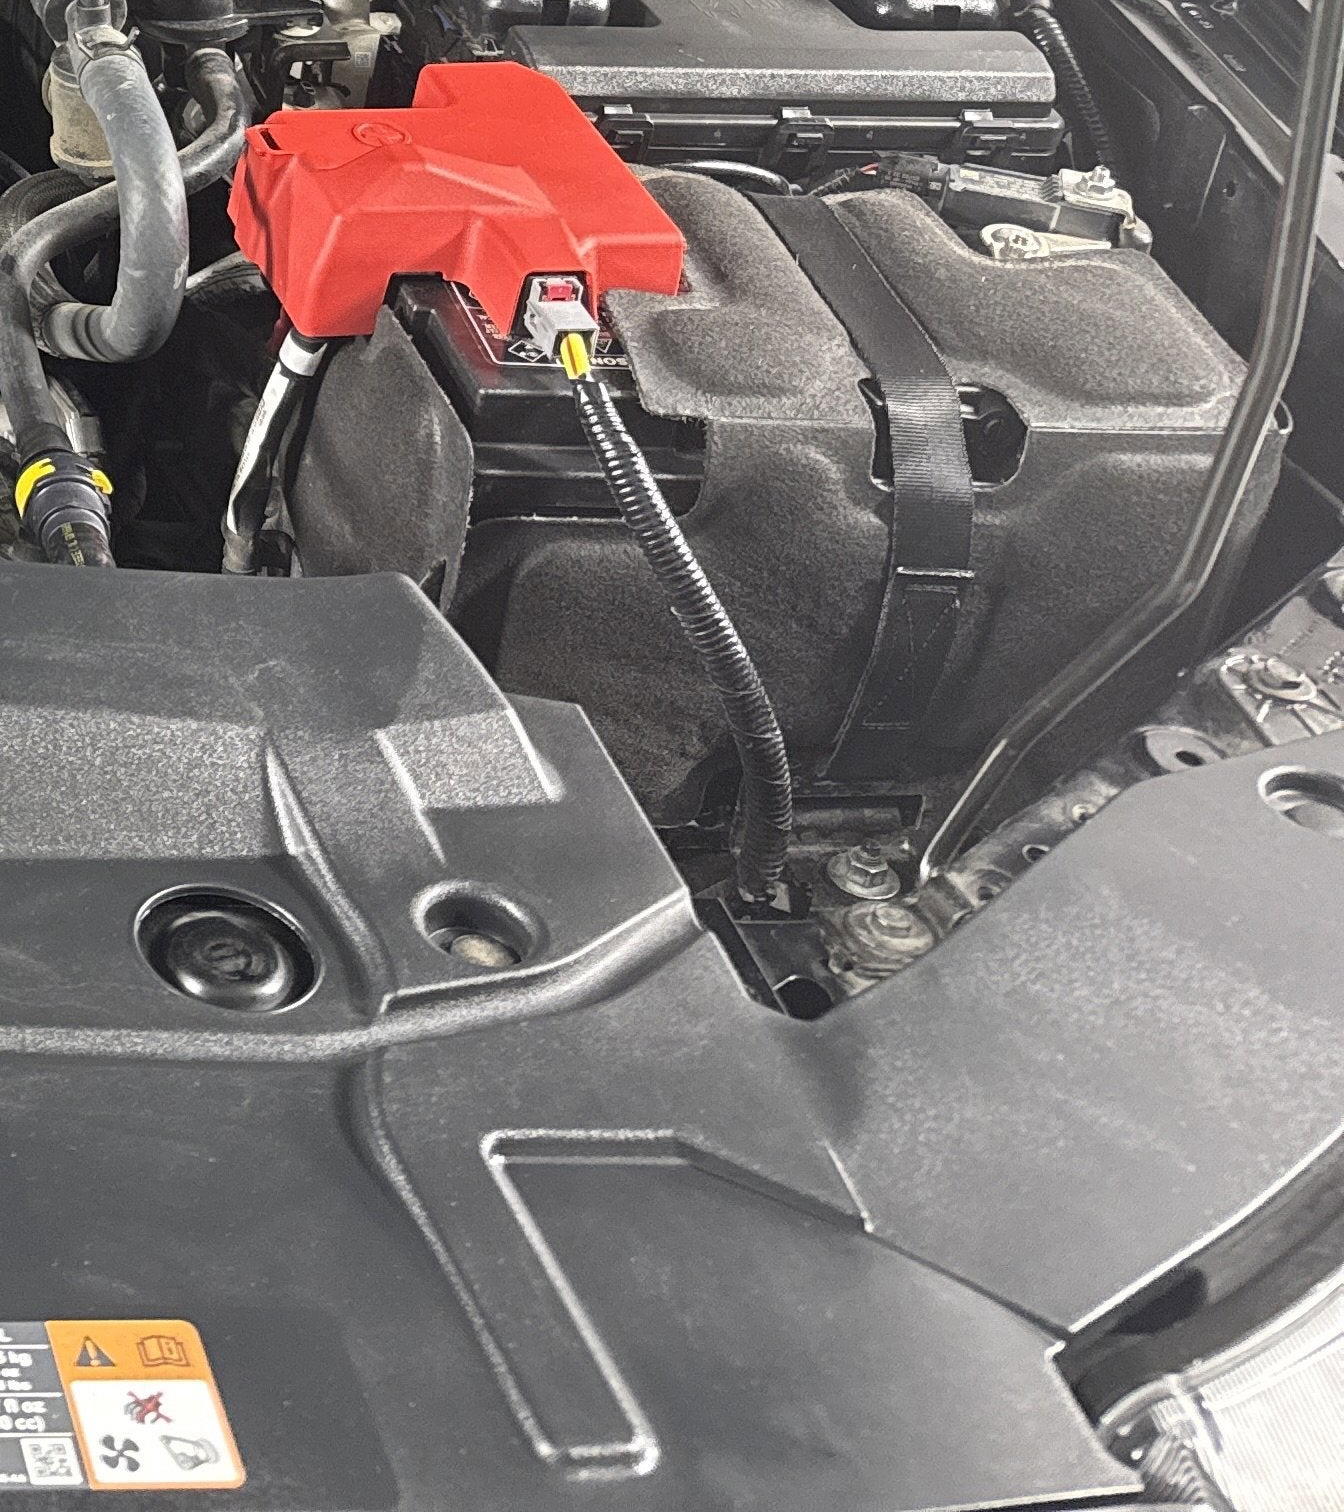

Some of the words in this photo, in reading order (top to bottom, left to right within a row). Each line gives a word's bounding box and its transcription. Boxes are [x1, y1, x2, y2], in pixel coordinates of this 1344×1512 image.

[7, 1351, 33, 1367] kg
[0, 1368, 20, 1378] oz
[3, 1398, 19, 1414] fl
[20, 1401, 48, 1414] oz
[14, 1415, 47, 1433] cc)
